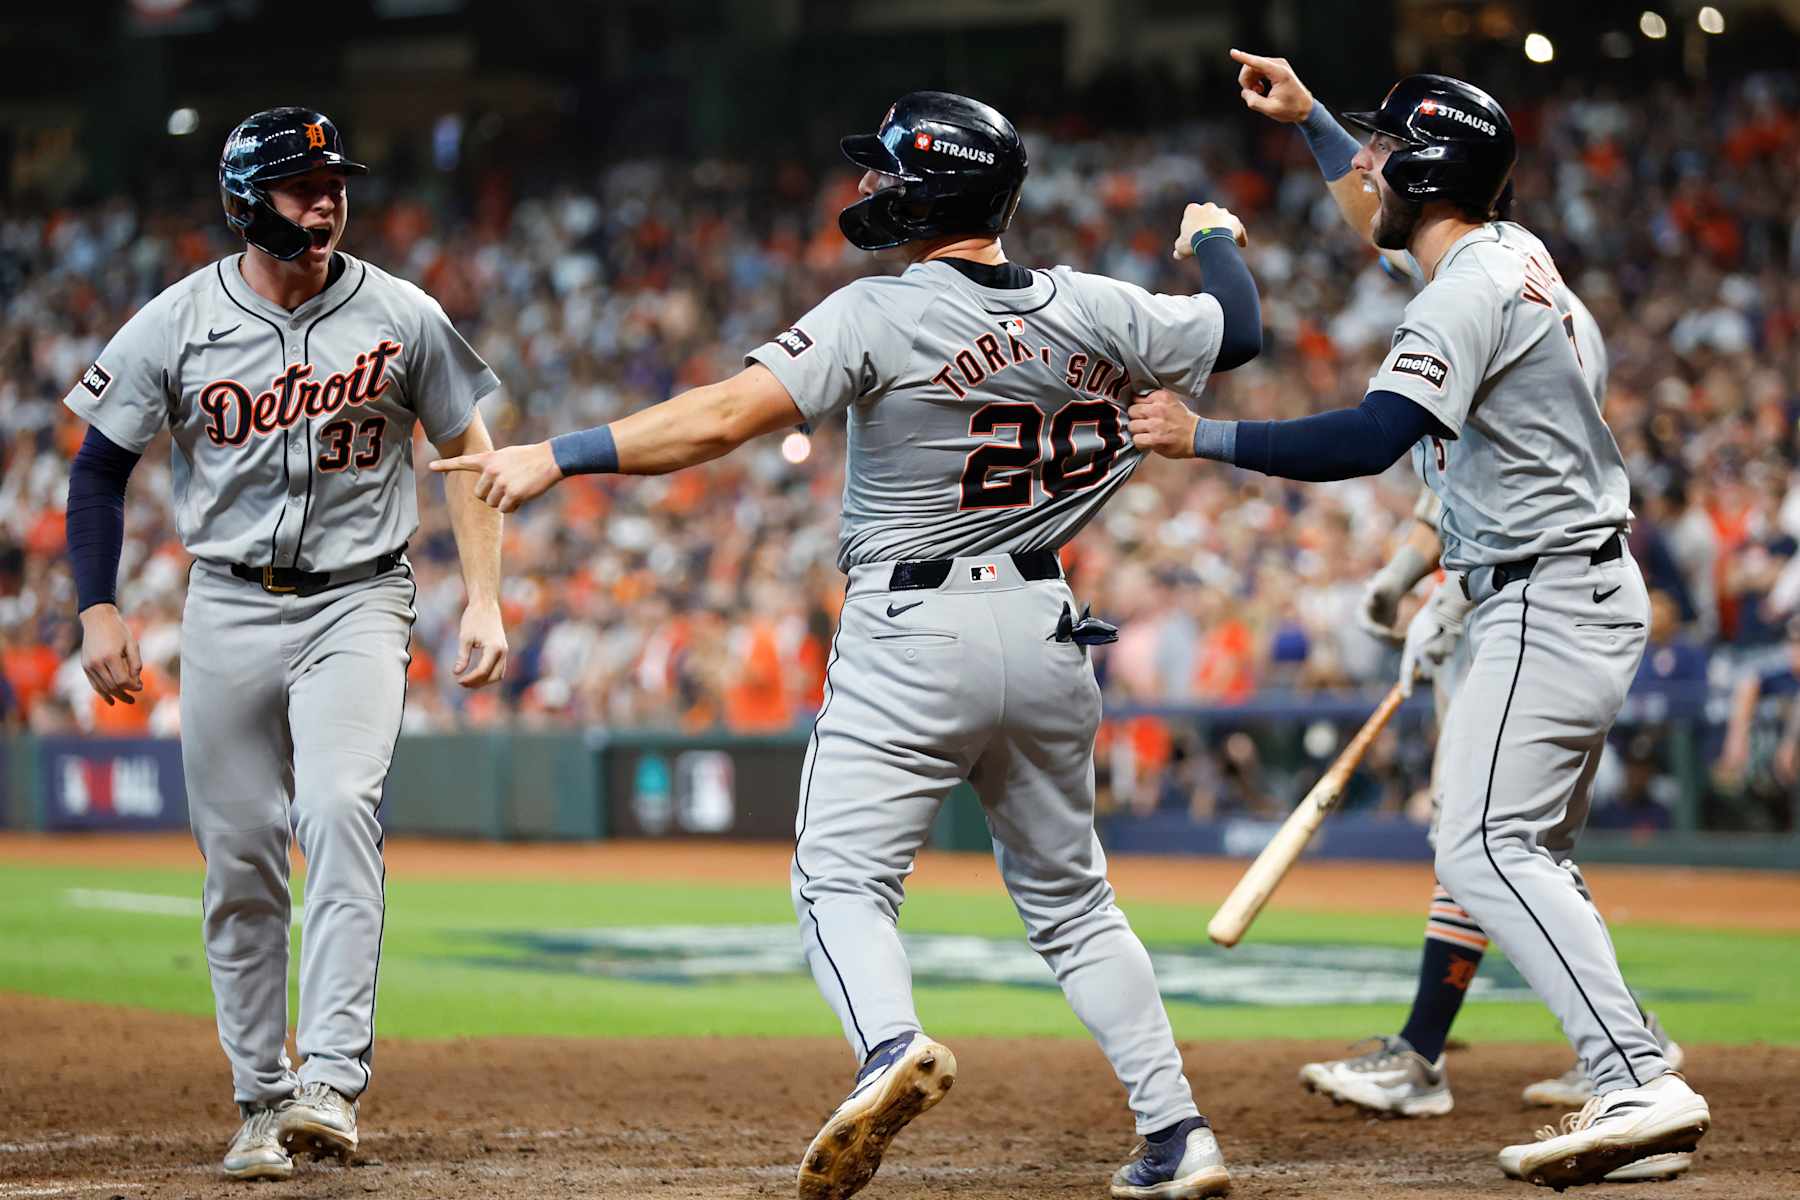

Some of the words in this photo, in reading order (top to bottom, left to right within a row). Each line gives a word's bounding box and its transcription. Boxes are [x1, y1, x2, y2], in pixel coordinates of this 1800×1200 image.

[302, 122, 327, 150] D
[1438, 104, 1497, 136] STRAUSS
[932, 139, 995, 165] STRAUSS
[1396, 356, 1445, 380] meijer
[199, 340, 402, 449] Detroit
[318, 415, 389, 473] 33
[957, 398, 1126, 513] 20
